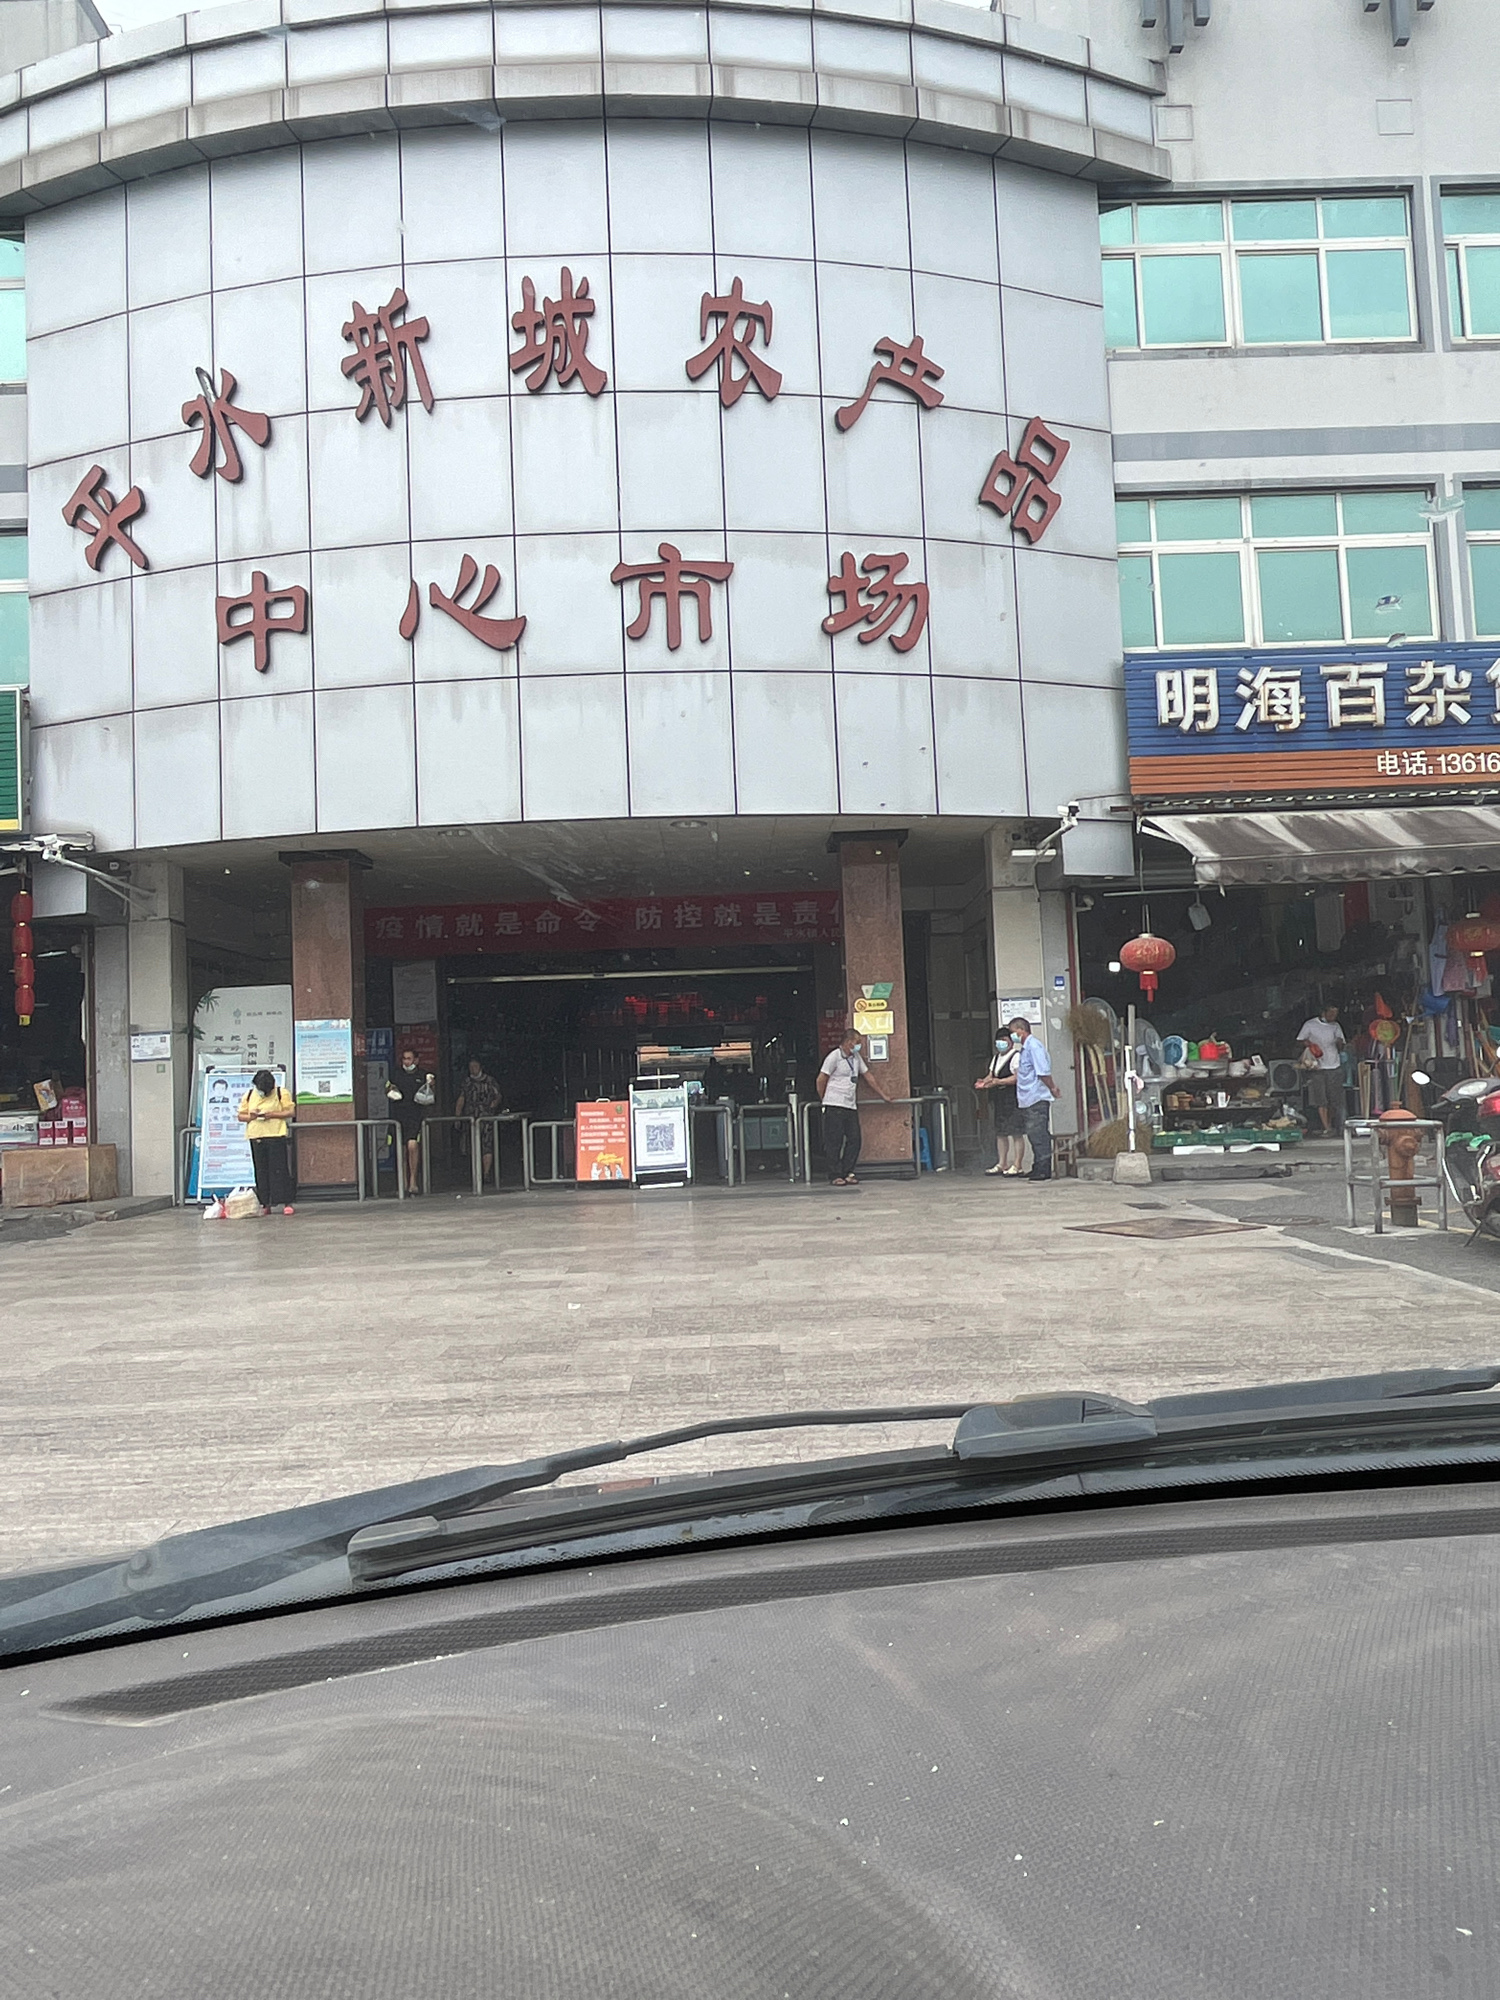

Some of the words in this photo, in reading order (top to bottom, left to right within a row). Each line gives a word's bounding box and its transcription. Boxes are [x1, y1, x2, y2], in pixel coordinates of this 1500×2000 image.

[62, 265, 1071, 572] 平水新城农产品
[216, 542, 930, 673] 中心市场
[859, 1015, 890, 1031] 入口
